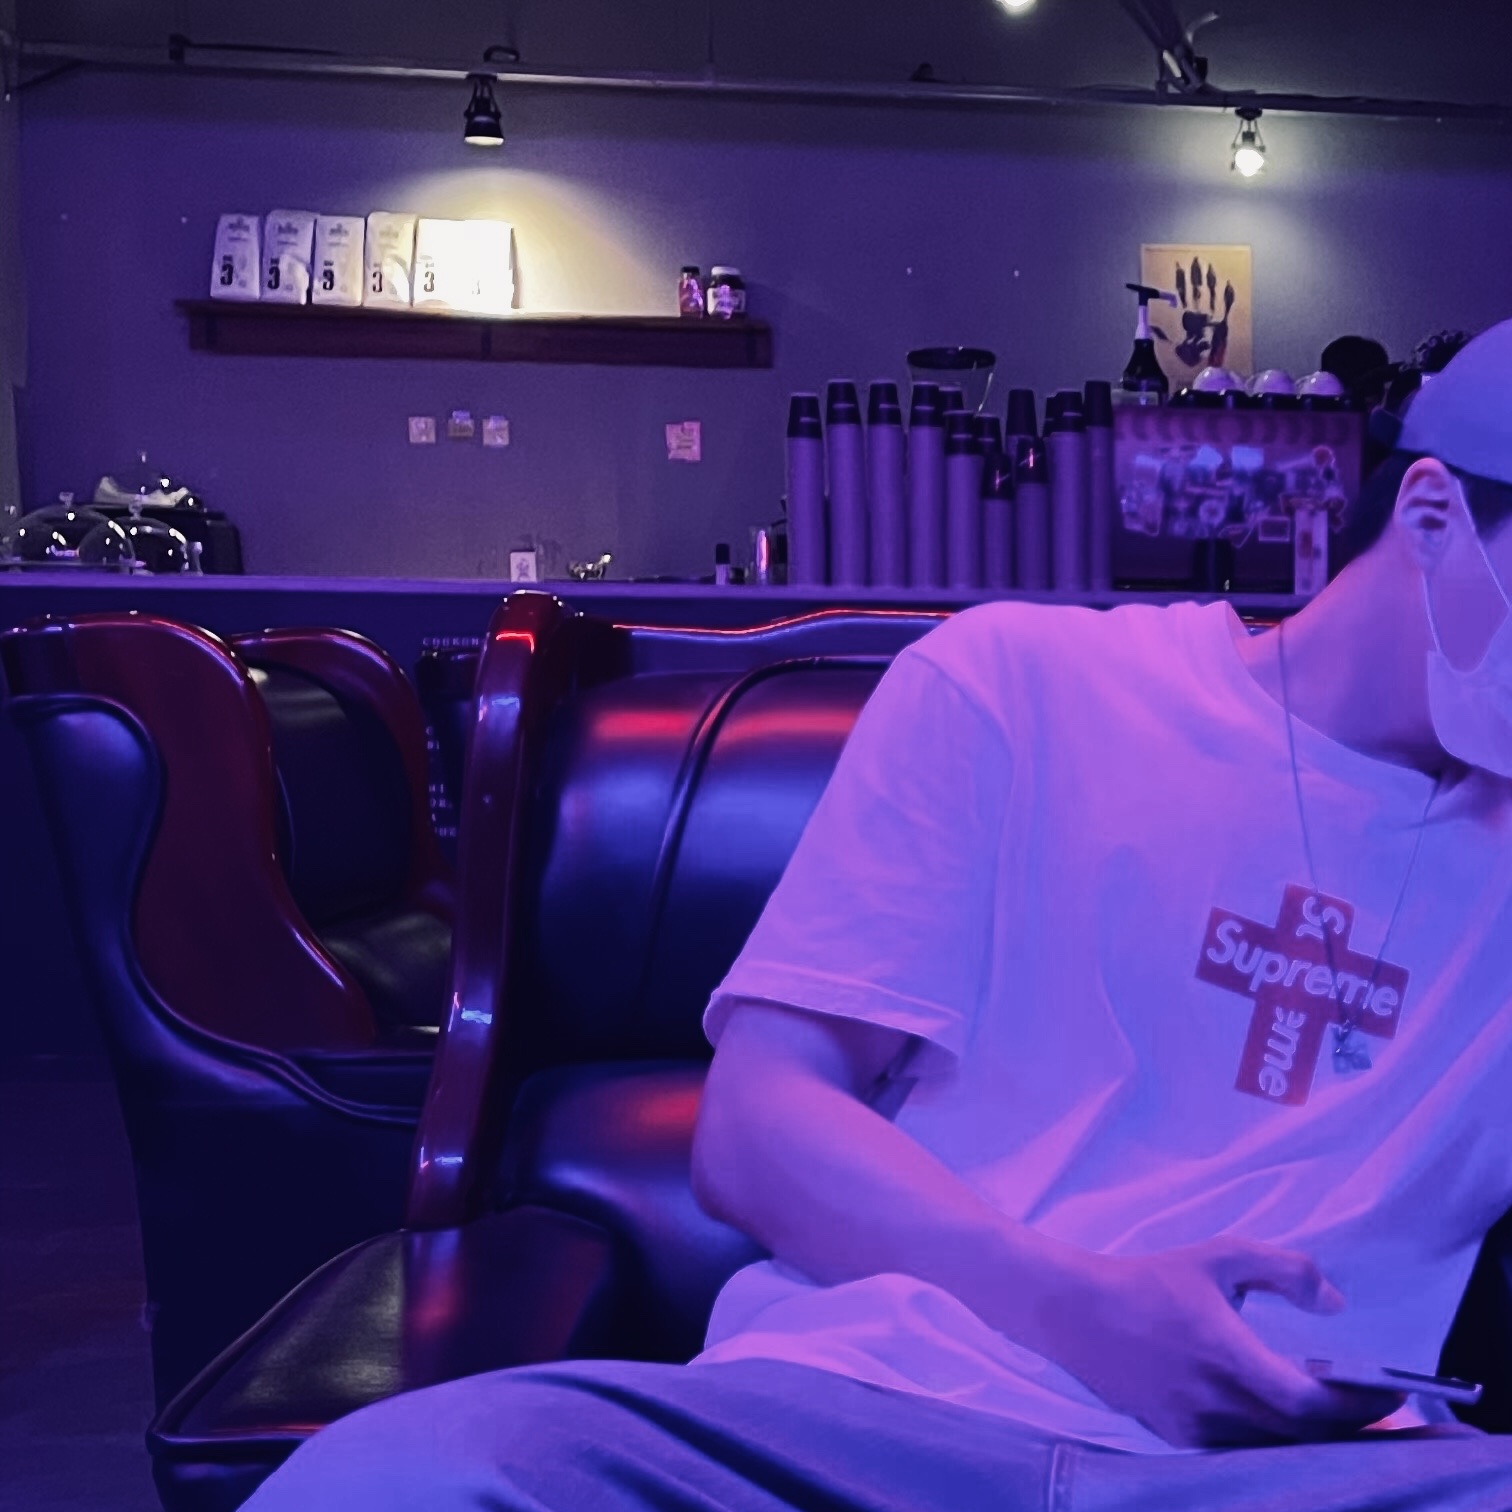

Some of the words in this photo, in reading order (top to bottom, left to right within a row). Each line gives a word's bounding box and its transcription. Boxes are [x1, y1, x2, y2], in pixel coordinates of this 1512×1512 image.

[220, 263, 234, 286] 3
[267, 266, 281, 290] 3
[1206, 919, 1399, 1017] Supreme
